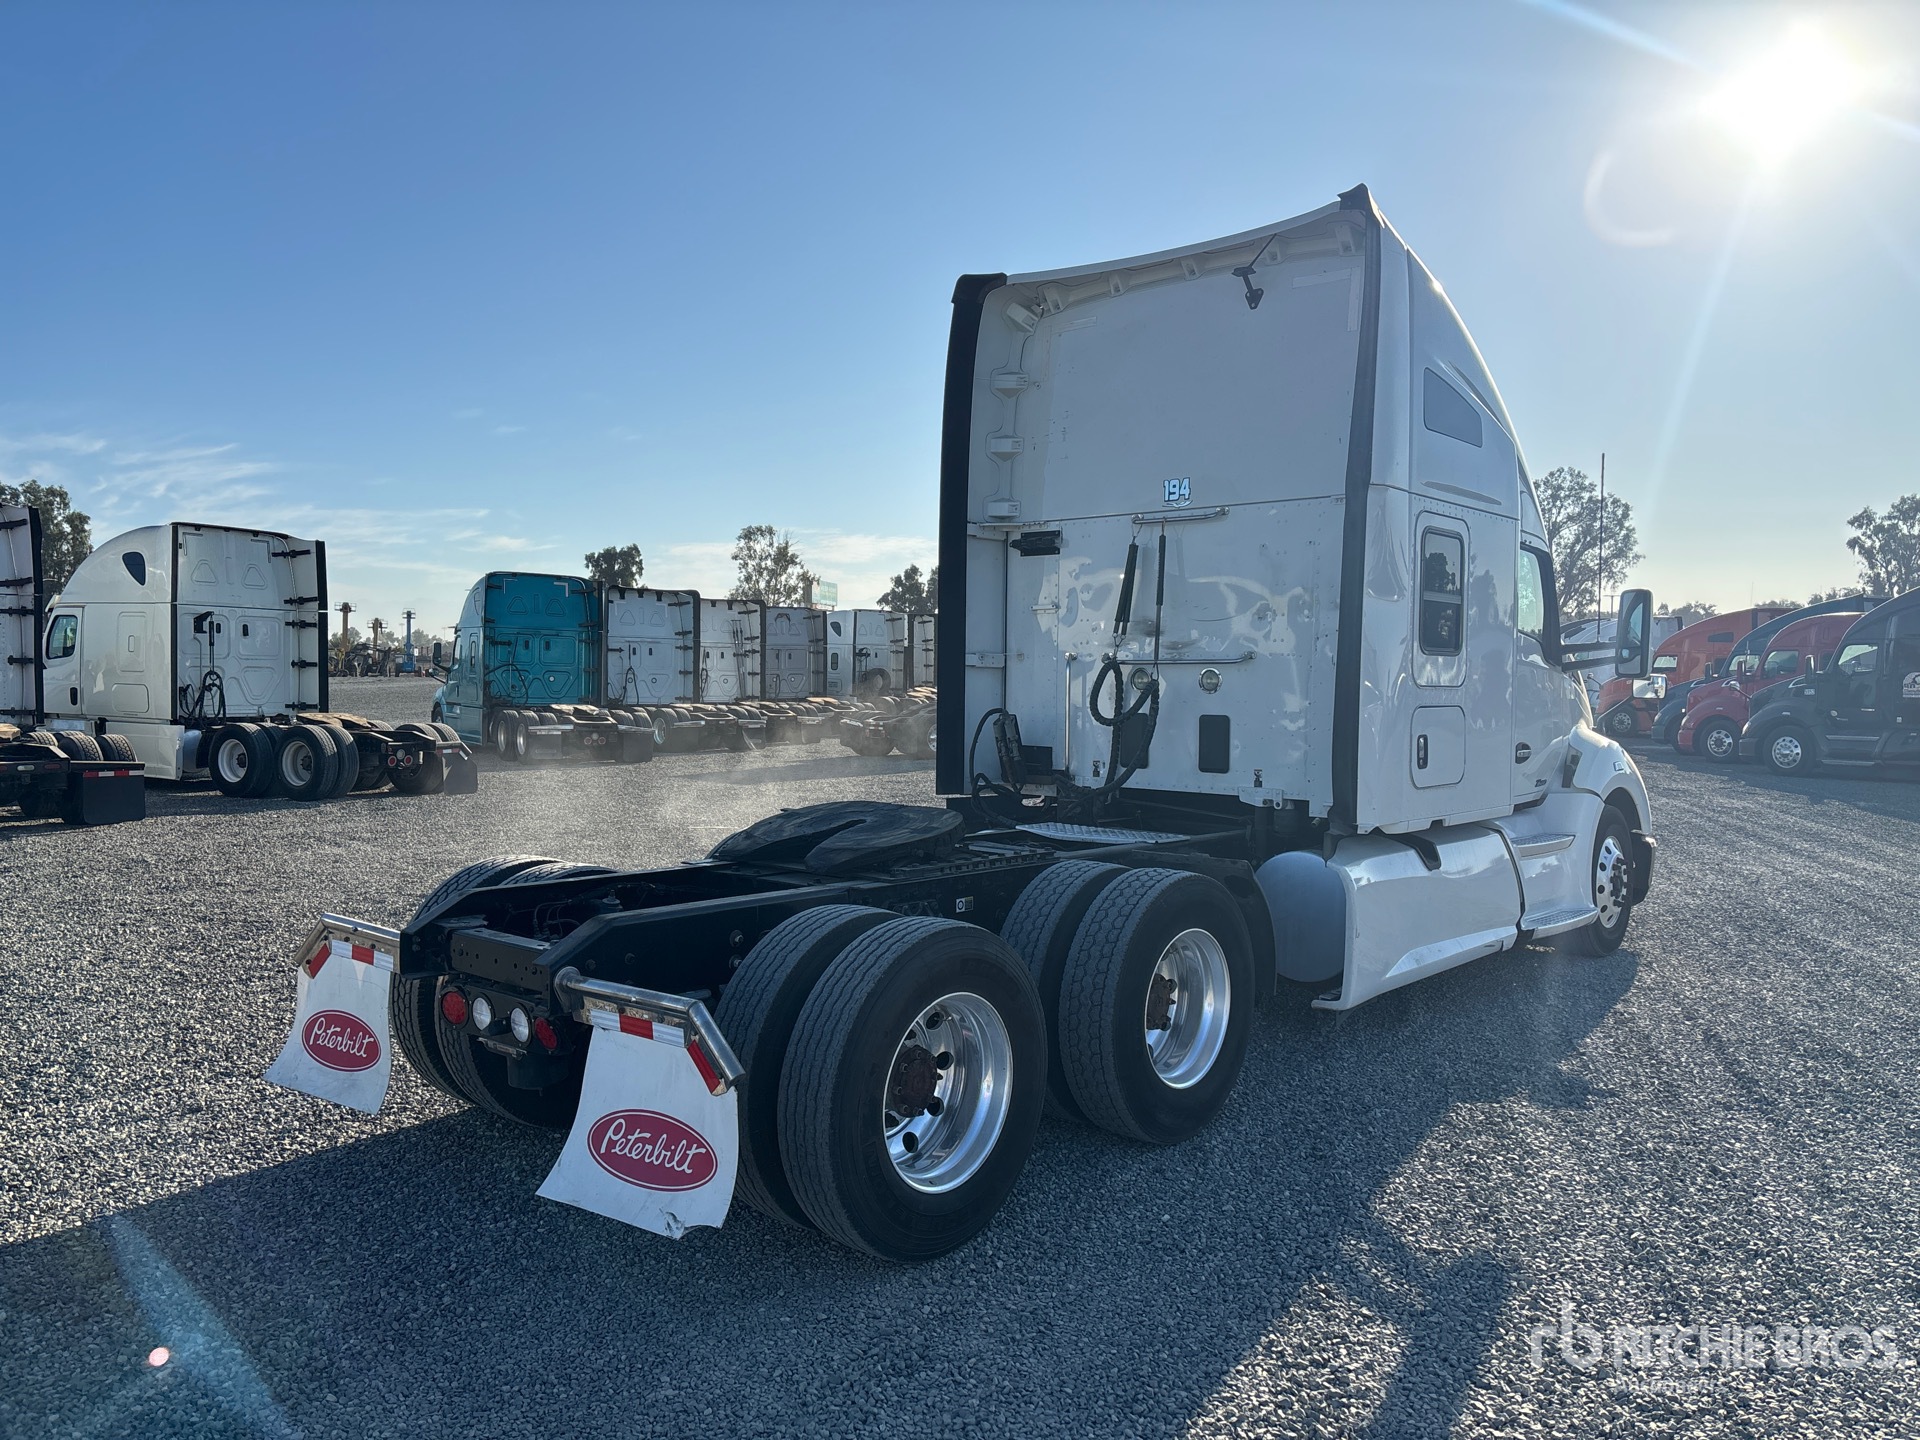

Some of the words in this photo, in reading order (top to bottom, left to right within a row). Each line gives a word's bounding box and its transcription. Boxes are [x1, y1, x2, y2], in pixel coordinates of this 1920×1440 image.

[1163, 477, 1191, 502] 194
[309, 1017, 374, 1058] Peterbilt
[600, 1118, 707, 1174] Peterbilt
